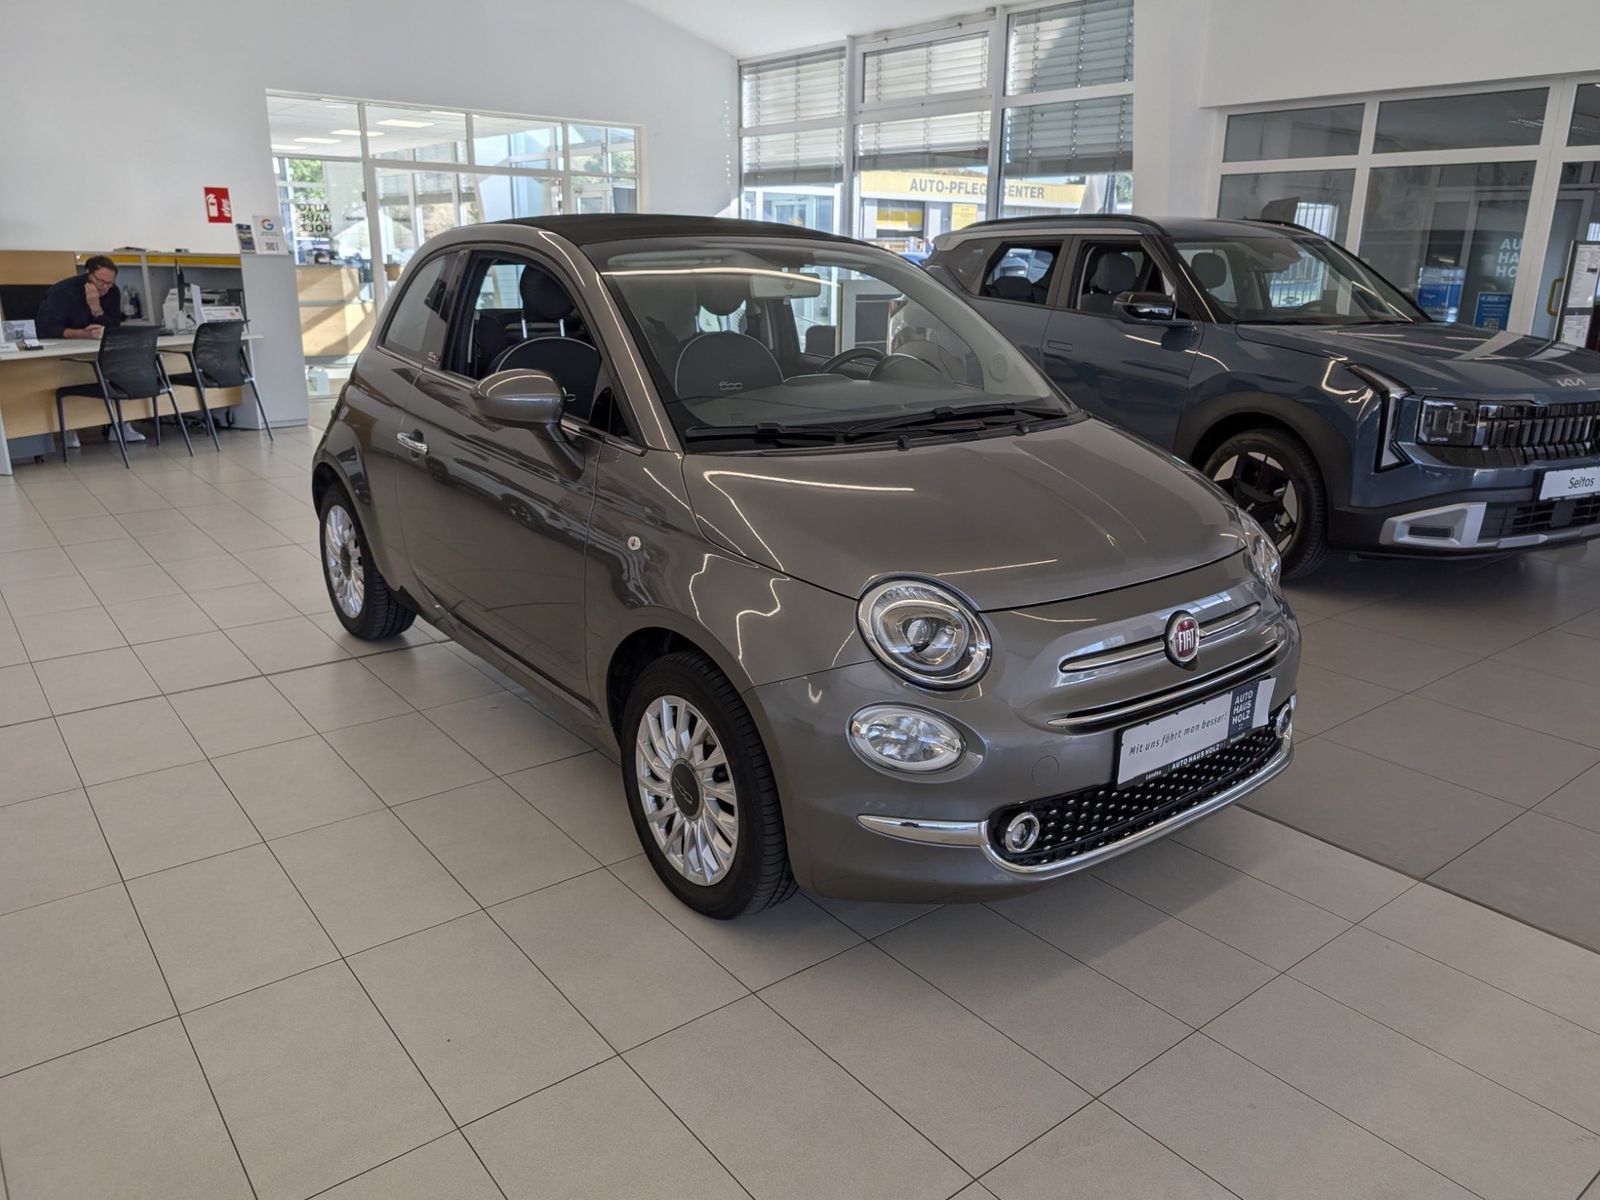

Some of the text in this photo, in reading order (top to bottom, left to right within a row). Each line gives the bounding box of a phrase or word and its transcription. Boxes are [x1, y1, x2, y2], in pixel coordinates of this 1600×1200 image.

[910, 178, 987, 196] AUTO-PFLEG
[1500, 238, 1522, 250] AU
[1498, 251, 1521, 264] HA
[1495, 265, 1518, 278] HO
[1568, 476, 1595, 489] Seltos
[1178, 629, 1195, 652] FIAT
[1235, 690, 1253, 703] AUTO
[1233, 700, 1252, 715] HAUS
[1232, 713, 1250, 725] HOLZ
[1128, 744, 1143, 756] Mit
[1145, 740, 1159, 750] uns
[1183, 724, 1200, 736] man
[1202, 712, 1227, 728] besser!
[1172, 759, 1187, 769] AUTO
[1188, 752, 1205, 762] HAUS
[1205, 743, 1220, 756] HOLZ
